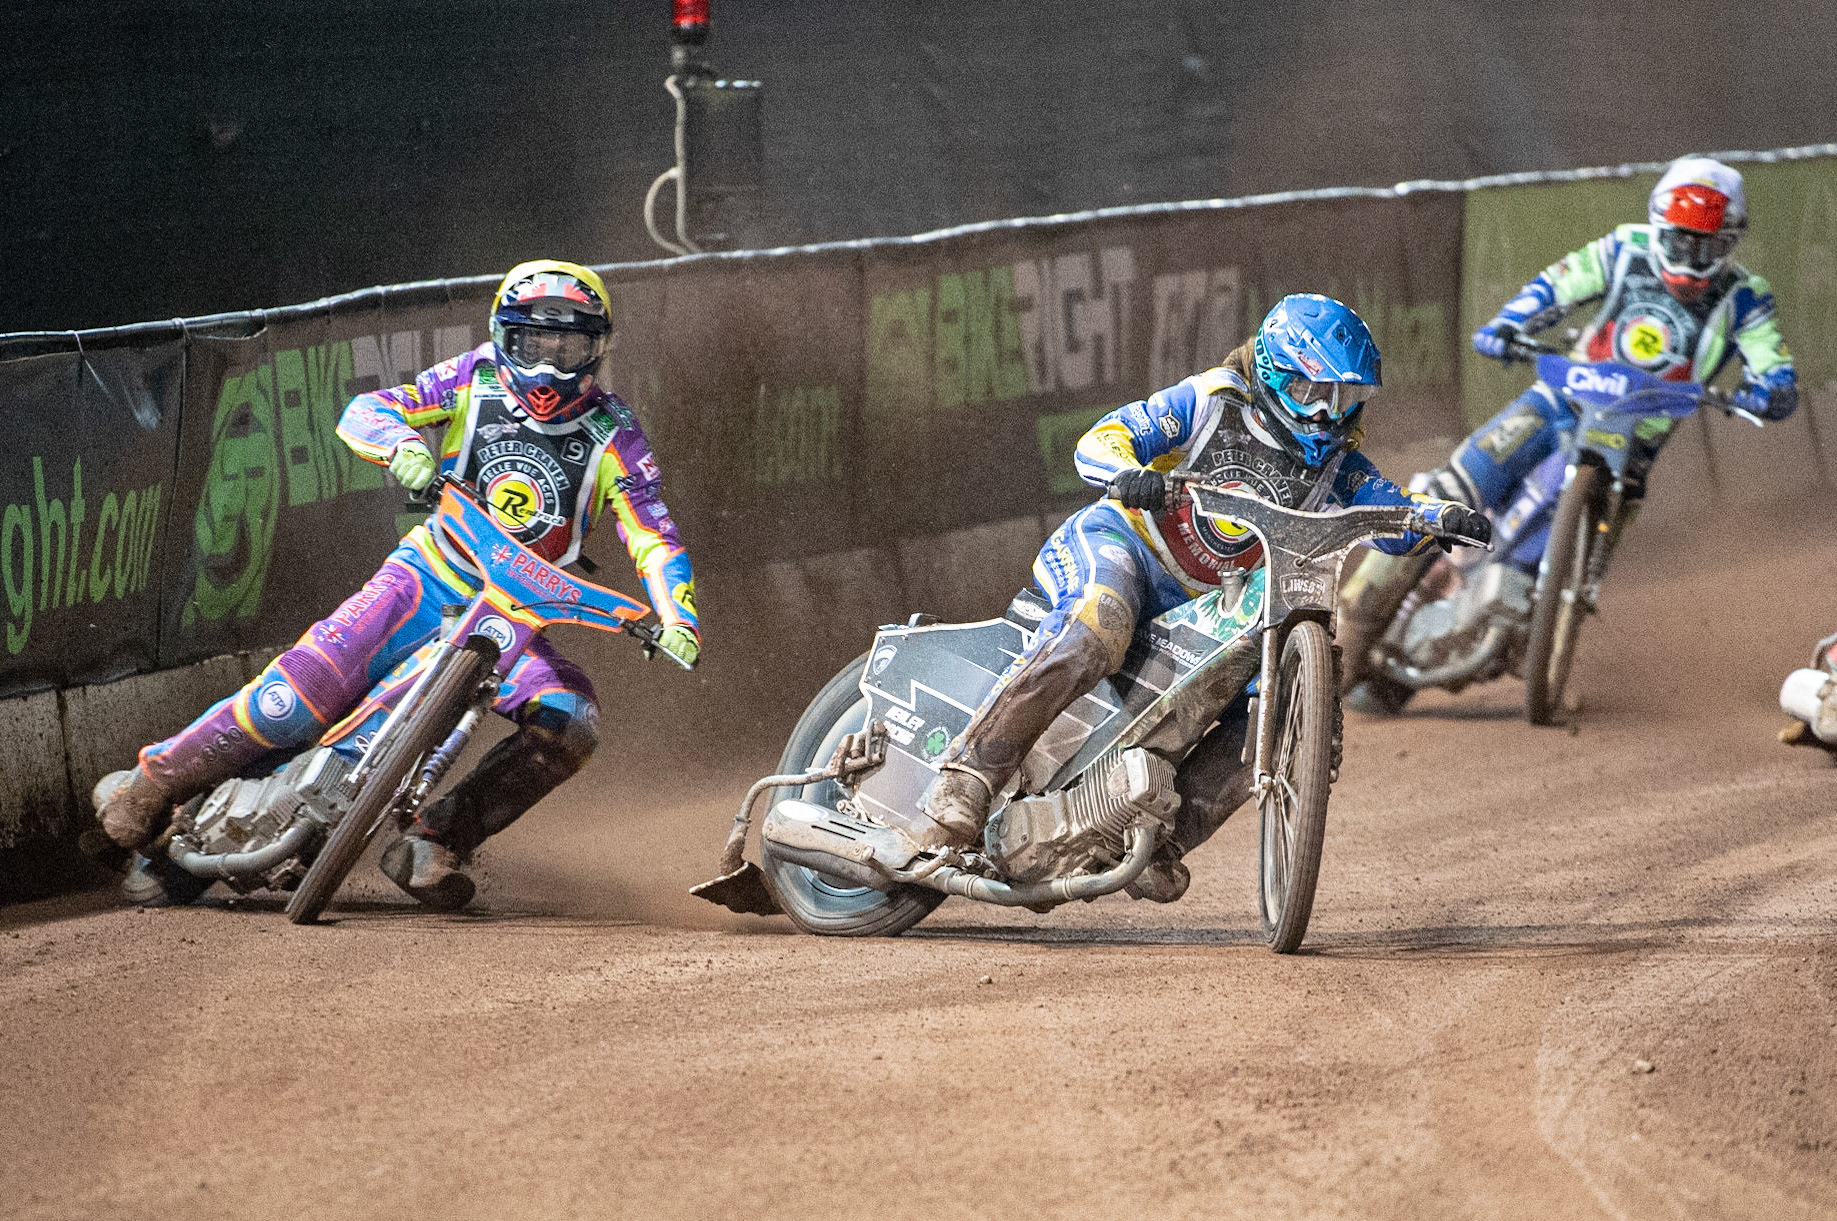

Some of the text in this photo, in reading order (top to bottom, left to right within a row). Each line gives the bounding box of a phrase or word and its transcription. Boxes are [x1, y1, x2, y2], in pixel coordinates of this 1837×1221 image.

[1566, 366, 1628, 397] Civil
[478, 441, 523, 463] PETER
[1211, 449, 1252, 467] PETER
[482, 462, 555, 504] BELLE VUE ACES
[1, 455, 162, 655] ght.com
[1177, 522, 1235, 570] MEMORIAL
[512, 551, 582, 606] PARRYS
[483, 625, 506, 643] ATPI
[267, 690, 286, 712] ATPI
